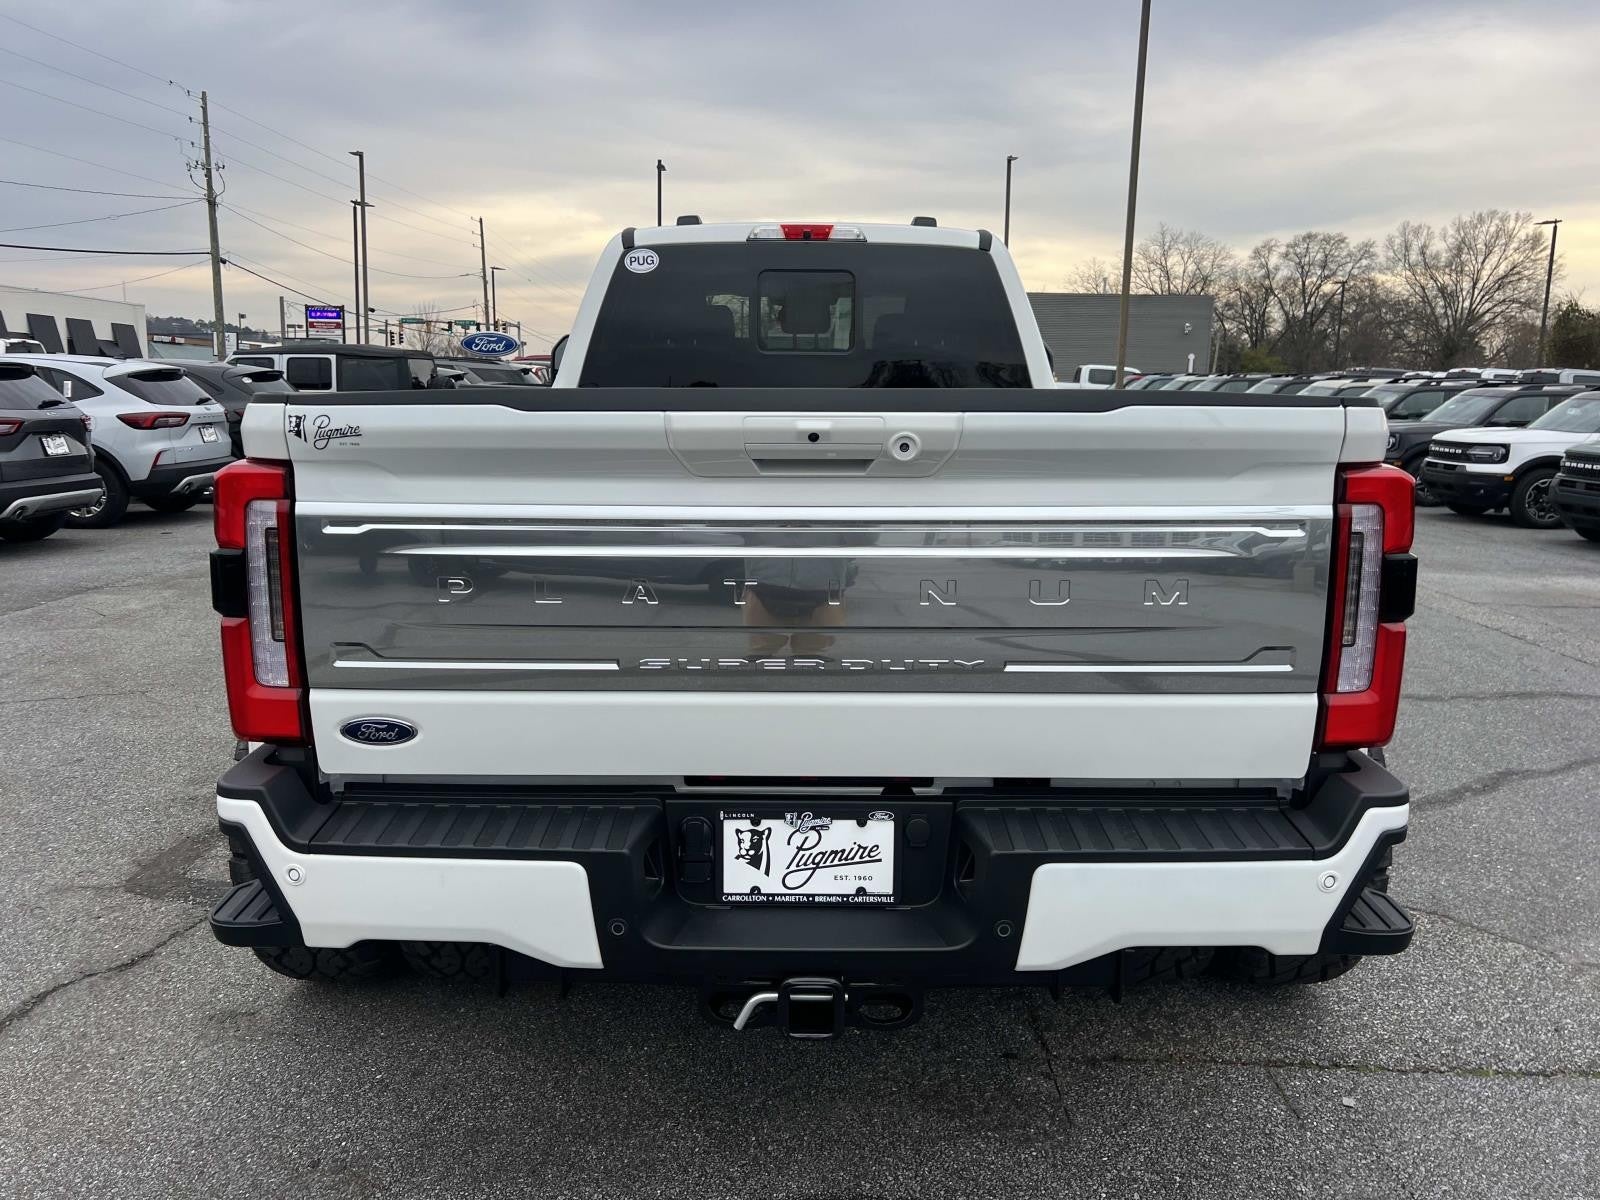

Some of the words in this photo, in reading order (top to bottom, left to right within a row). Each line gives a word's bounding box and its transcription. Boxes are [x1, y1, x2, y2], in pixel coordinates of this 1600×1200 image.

[629, 255, 655, 266] PUG
[472, 336, 506, 351] Ford
[313, 414, 362, 450] Pugmire
[1564, 461, 1600, 470] BRONC
[437, 576, 1189, 605] PLATINUM
[357, 723, 399, 740] Ford
[782, 828, 882, 890] Pugmire
